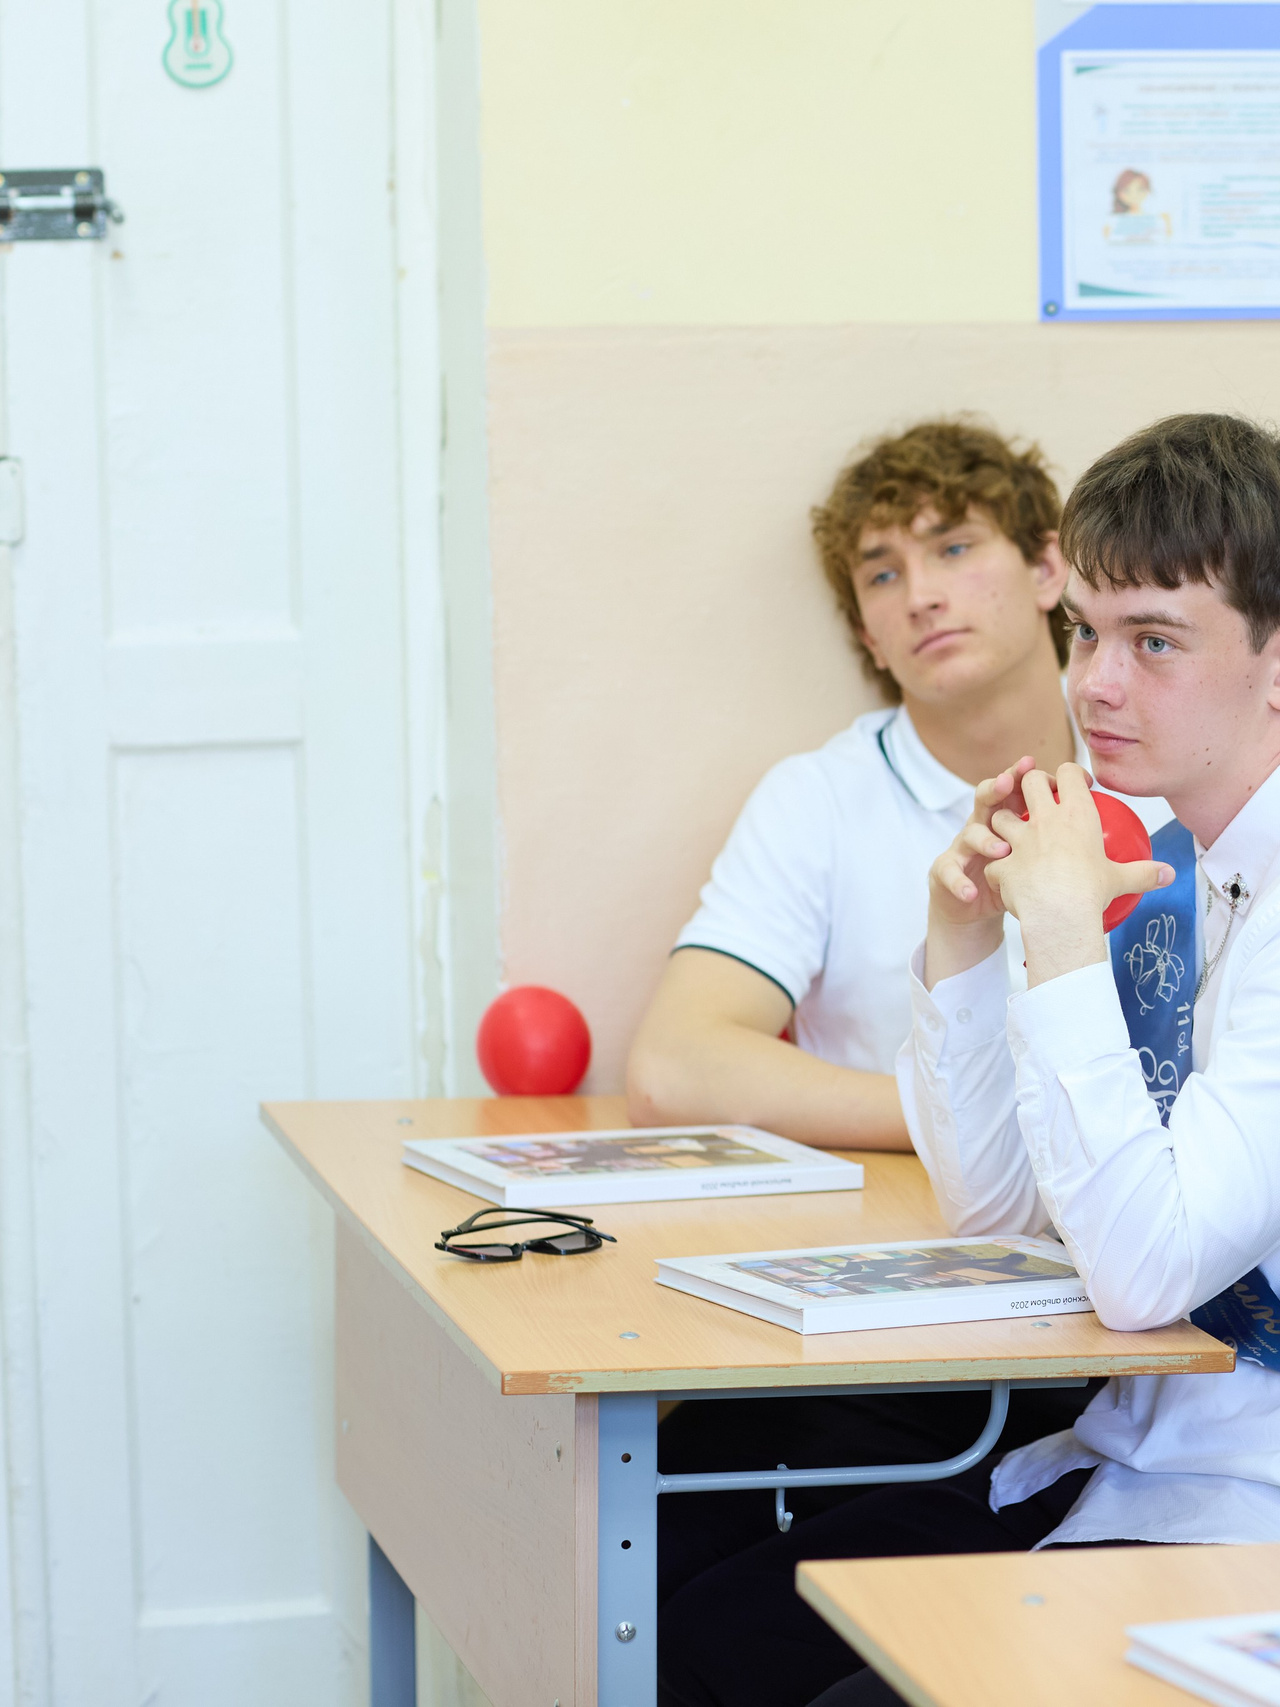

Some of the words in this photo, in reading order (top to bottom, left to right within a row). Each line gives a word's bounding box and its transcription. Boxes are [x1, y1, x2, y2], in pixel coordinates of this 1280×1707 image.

[1010, 1300, 1029, 1310] 2026
[1030, 1297, 1061, 1308] альбом
[1062, 1295, 1091, 1305] ускной
